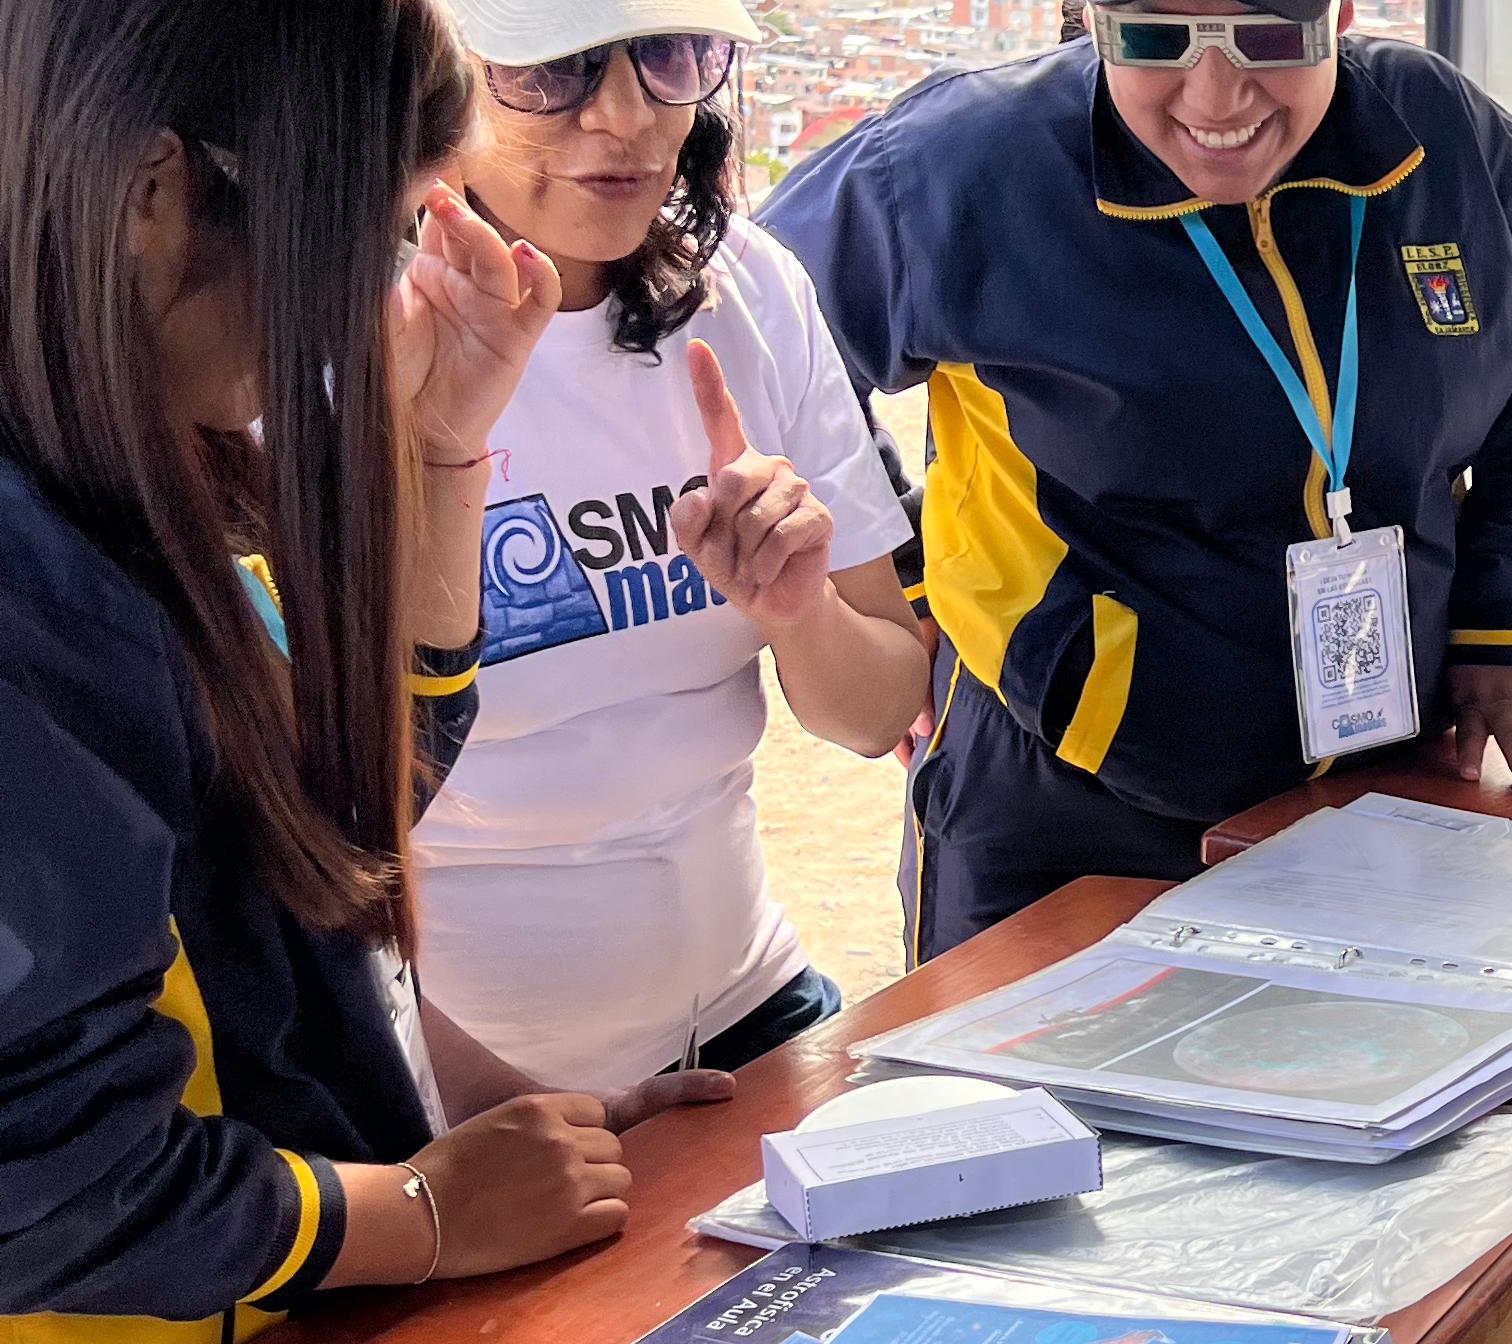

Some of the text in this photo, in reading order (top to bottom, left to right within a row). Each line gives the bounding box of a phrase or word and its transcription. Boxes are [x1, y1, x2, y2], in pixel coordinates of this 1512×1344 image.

[604, 554, 728, 632] ma
[706, 1266, 803, 1330] en el Aula
